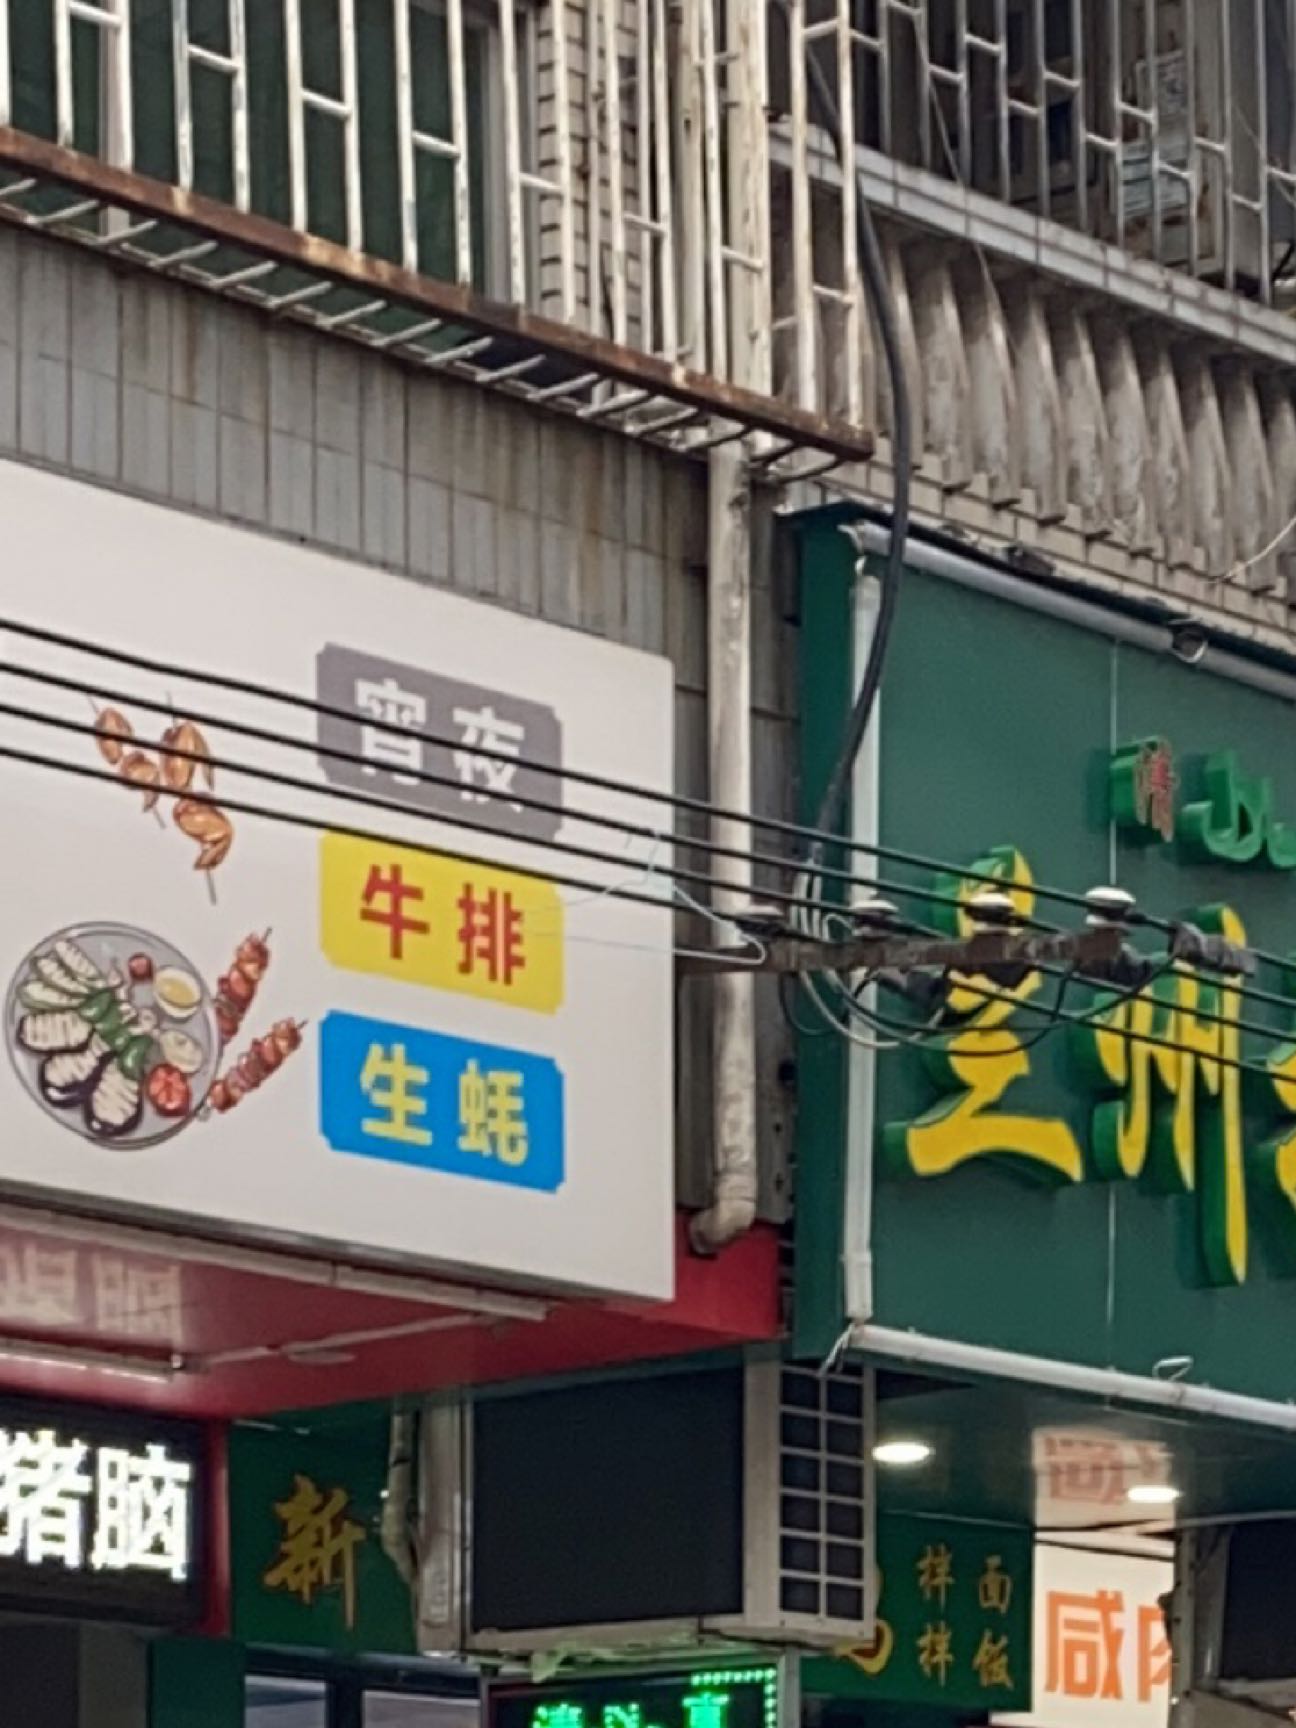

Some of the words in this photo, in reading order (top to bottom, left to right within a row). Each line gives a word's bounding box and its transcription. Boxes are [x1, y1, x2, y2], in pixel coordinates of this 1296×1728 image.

[359, 863, 526, 987] 牛排
[360, 1042, 529, 1167] 生蚝
[263, 1474, 366, 1631] 新
